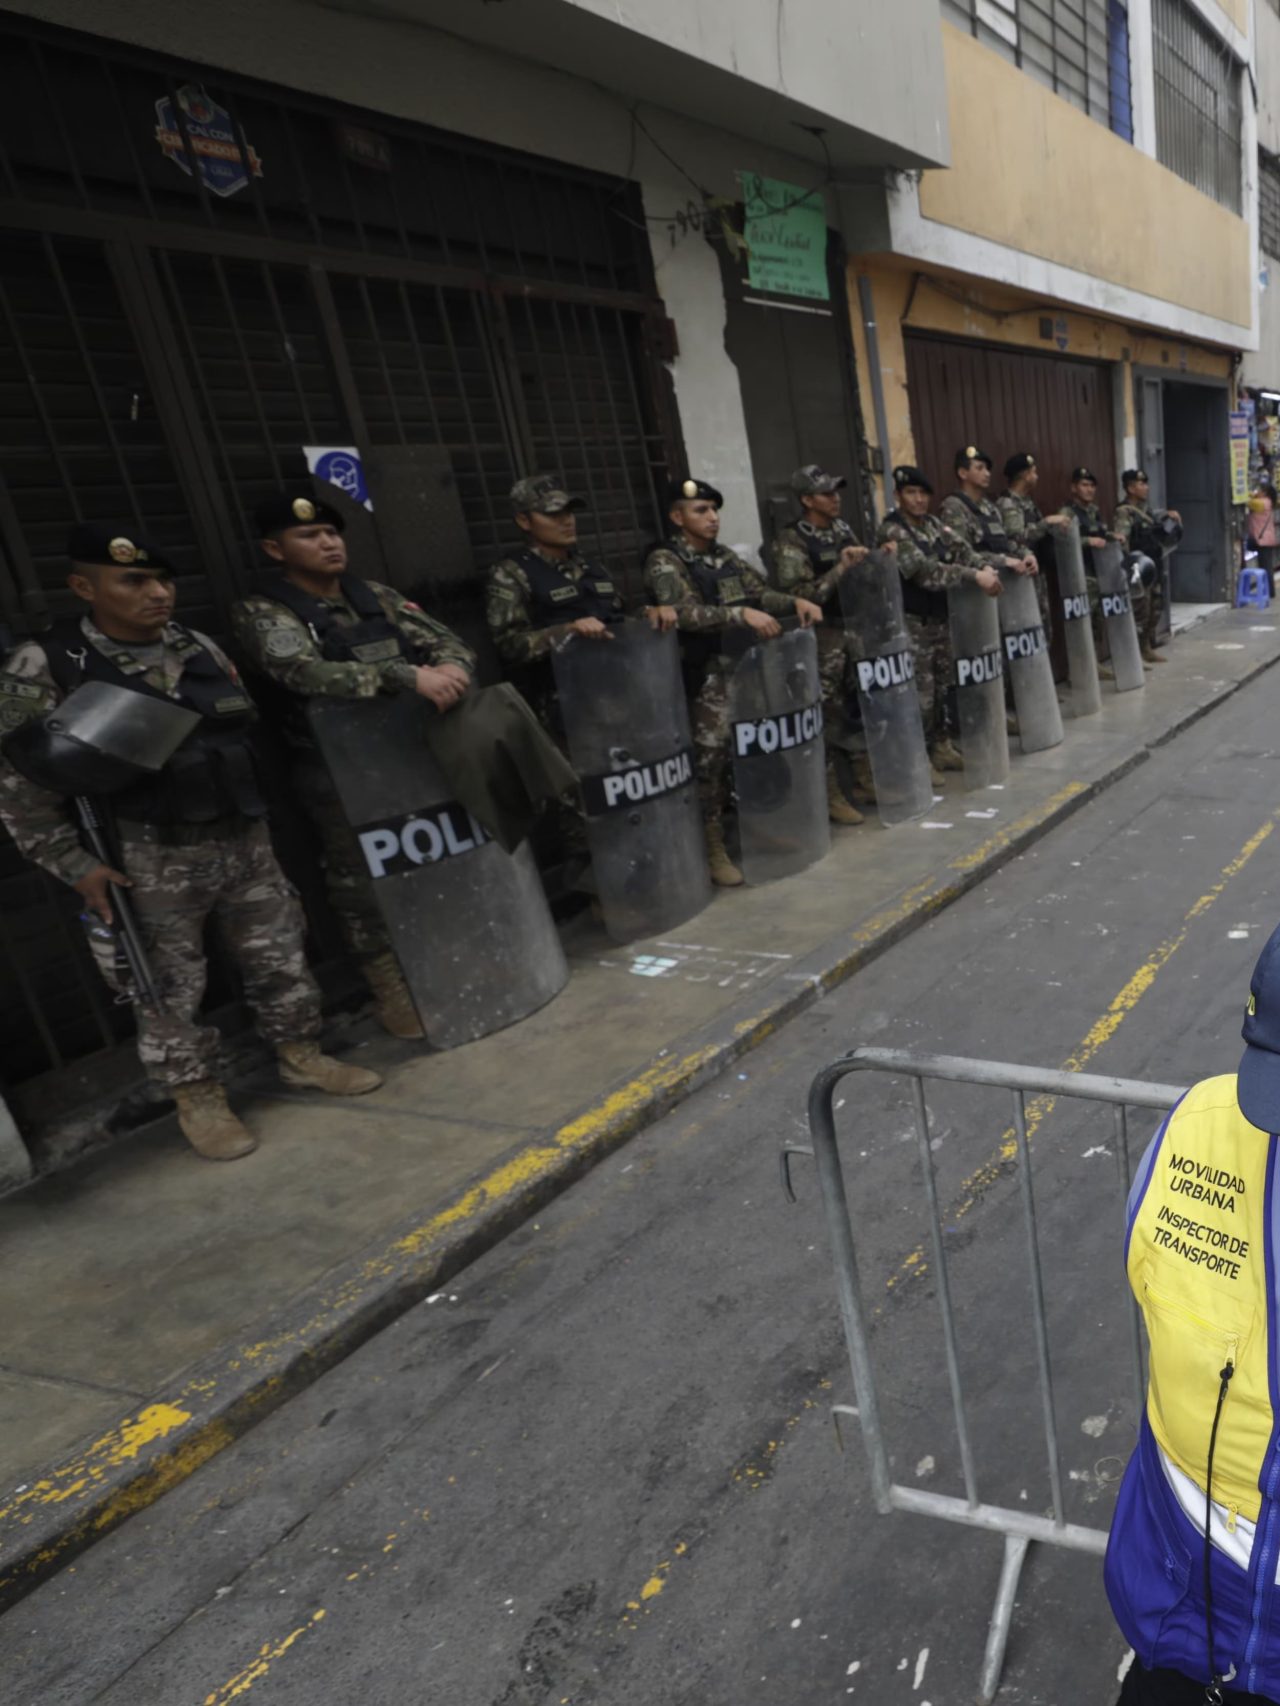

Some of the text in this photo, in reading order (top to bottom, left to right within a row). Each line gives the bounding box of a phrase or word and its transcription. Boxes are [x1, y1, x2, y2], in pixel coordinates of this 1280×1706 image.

[602, 752, 692, 807] POLICIA
[357, 811, 493, 879] POLI
[1169, 1154, 1245, 1194] MOVILIDAD
[1170, 1175, 1235, 1213] URBANA
[1153, 1227, 1240, 1280] TRANSPORTE
[1157, 1205, 1249, 1258] INSPECTOR DE
